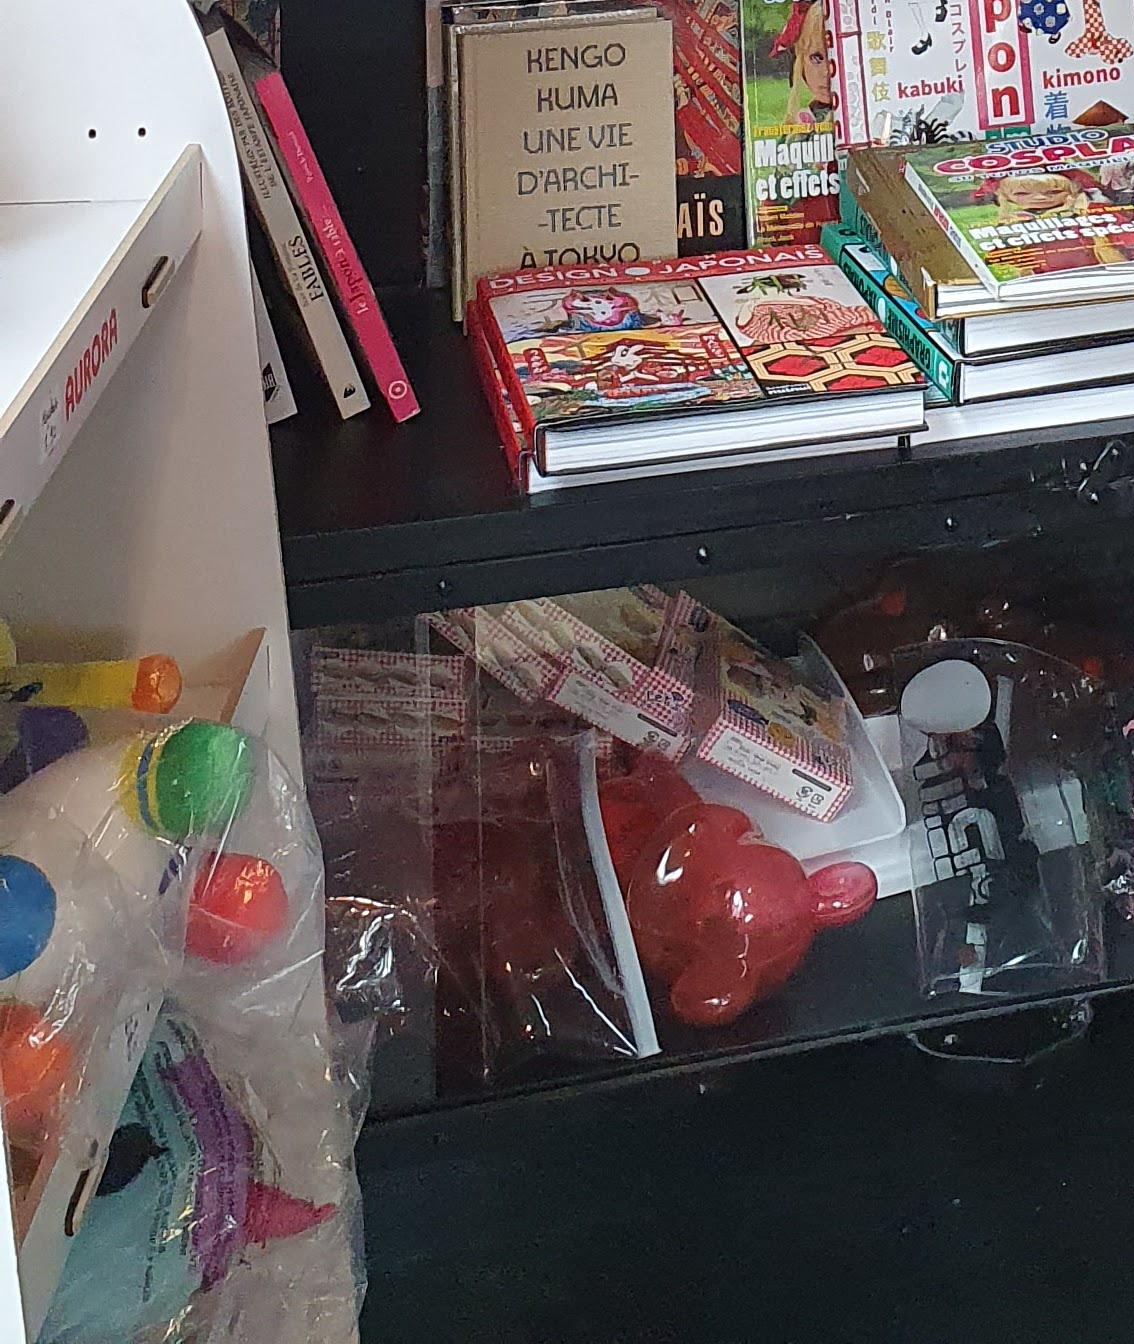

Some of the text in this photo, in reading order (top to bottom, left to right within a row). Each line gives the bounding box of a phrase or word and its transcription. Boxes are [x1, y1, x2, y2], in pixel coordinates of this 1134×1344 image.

[949, 4, 967, 72] コスプレ
[527, 43, 626, 73] KENGO
[897, 75, 964, 99] kabuki
[1042, 65, 1121, 89] kimono
[537, 83, 619, 113] KUMA
[523, 123, 632, 153] UNE VIE
[985, 130, 1108, 153] STUDIO
[517, 163, 639, 196] D'ARCHI-
[756, 172, 839, 200] et effets
[969, 213, 1118, 240] Maquillages
[549, 242, 640, 264] TOKYO
[981, 238, 1006, 251] et
[288, 235, 323, 300] FABLES
[489, 248, 823, 291] DESIGN JAPONAIS
[64, 308, 118, 422] AURORA
